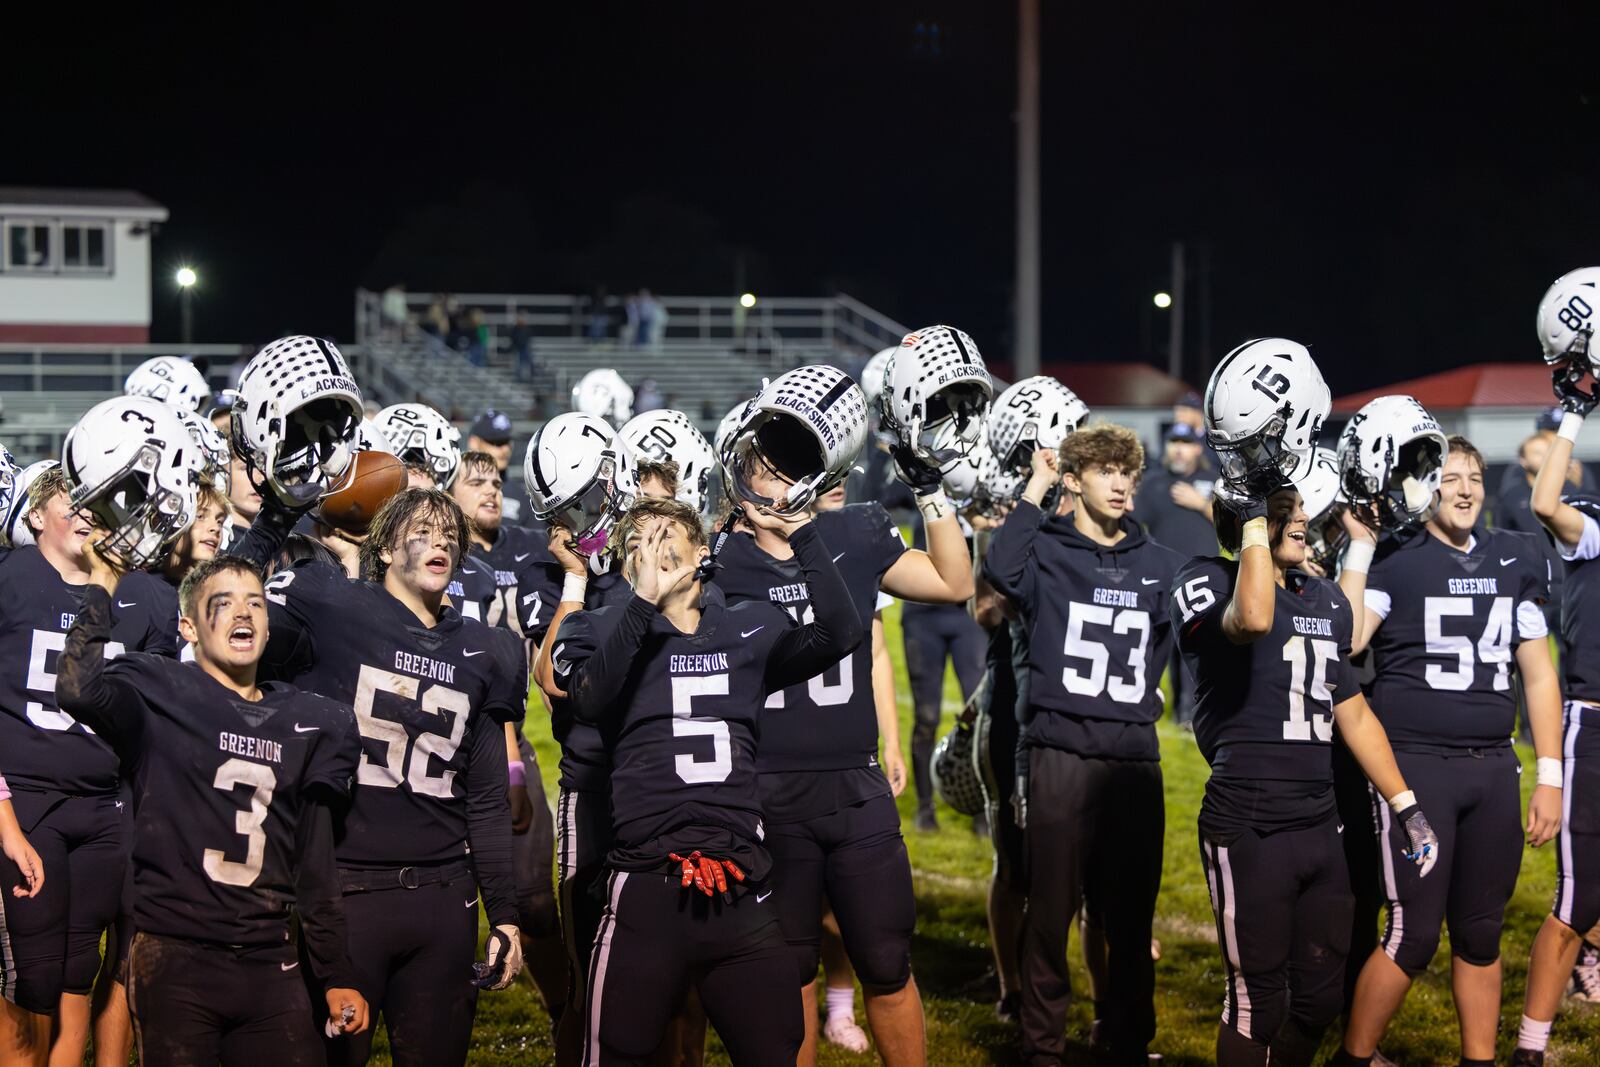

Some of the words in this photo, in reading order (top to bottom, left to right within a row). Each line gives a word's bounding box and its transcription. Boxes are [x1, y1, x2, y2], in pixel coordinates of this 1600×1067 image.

[1558, 295, 1593, 331] 80
[1008, 386, 1042, 413] 55
[1251, 364, 1290, 403] 15
[121, 410, 155, 434] 3
[387, 408, 418, 426] 78
[774, 396, 837, 450] BLACKSHIRTS
[581, 424, 613, 449] 7
[637, 425, 677, 462] 50
[545, 495, 562, 508] MOG
[1092, 587, 1139, 609] GREENON
[1173, 575, 1217, 623] 15
[1447, 577, 1499, 595] GREENON
[522, 590, 542, 629] 7
[1292, 615, 1334, 637] GREENON
[1061, 600, 1152, 704] 53
[1424, 596, 1515, 692] 54
[394, 650, 456, 685] GREENON
[669, 652, 731, 677] GREENON
[1282, 634, 1342, 743] 15
[353, 663, 472, 800] 52
[671, 672, 734, 786] 5
[218, 730, 284, 766] GREENON
[201, 758, 279, 889] 3
